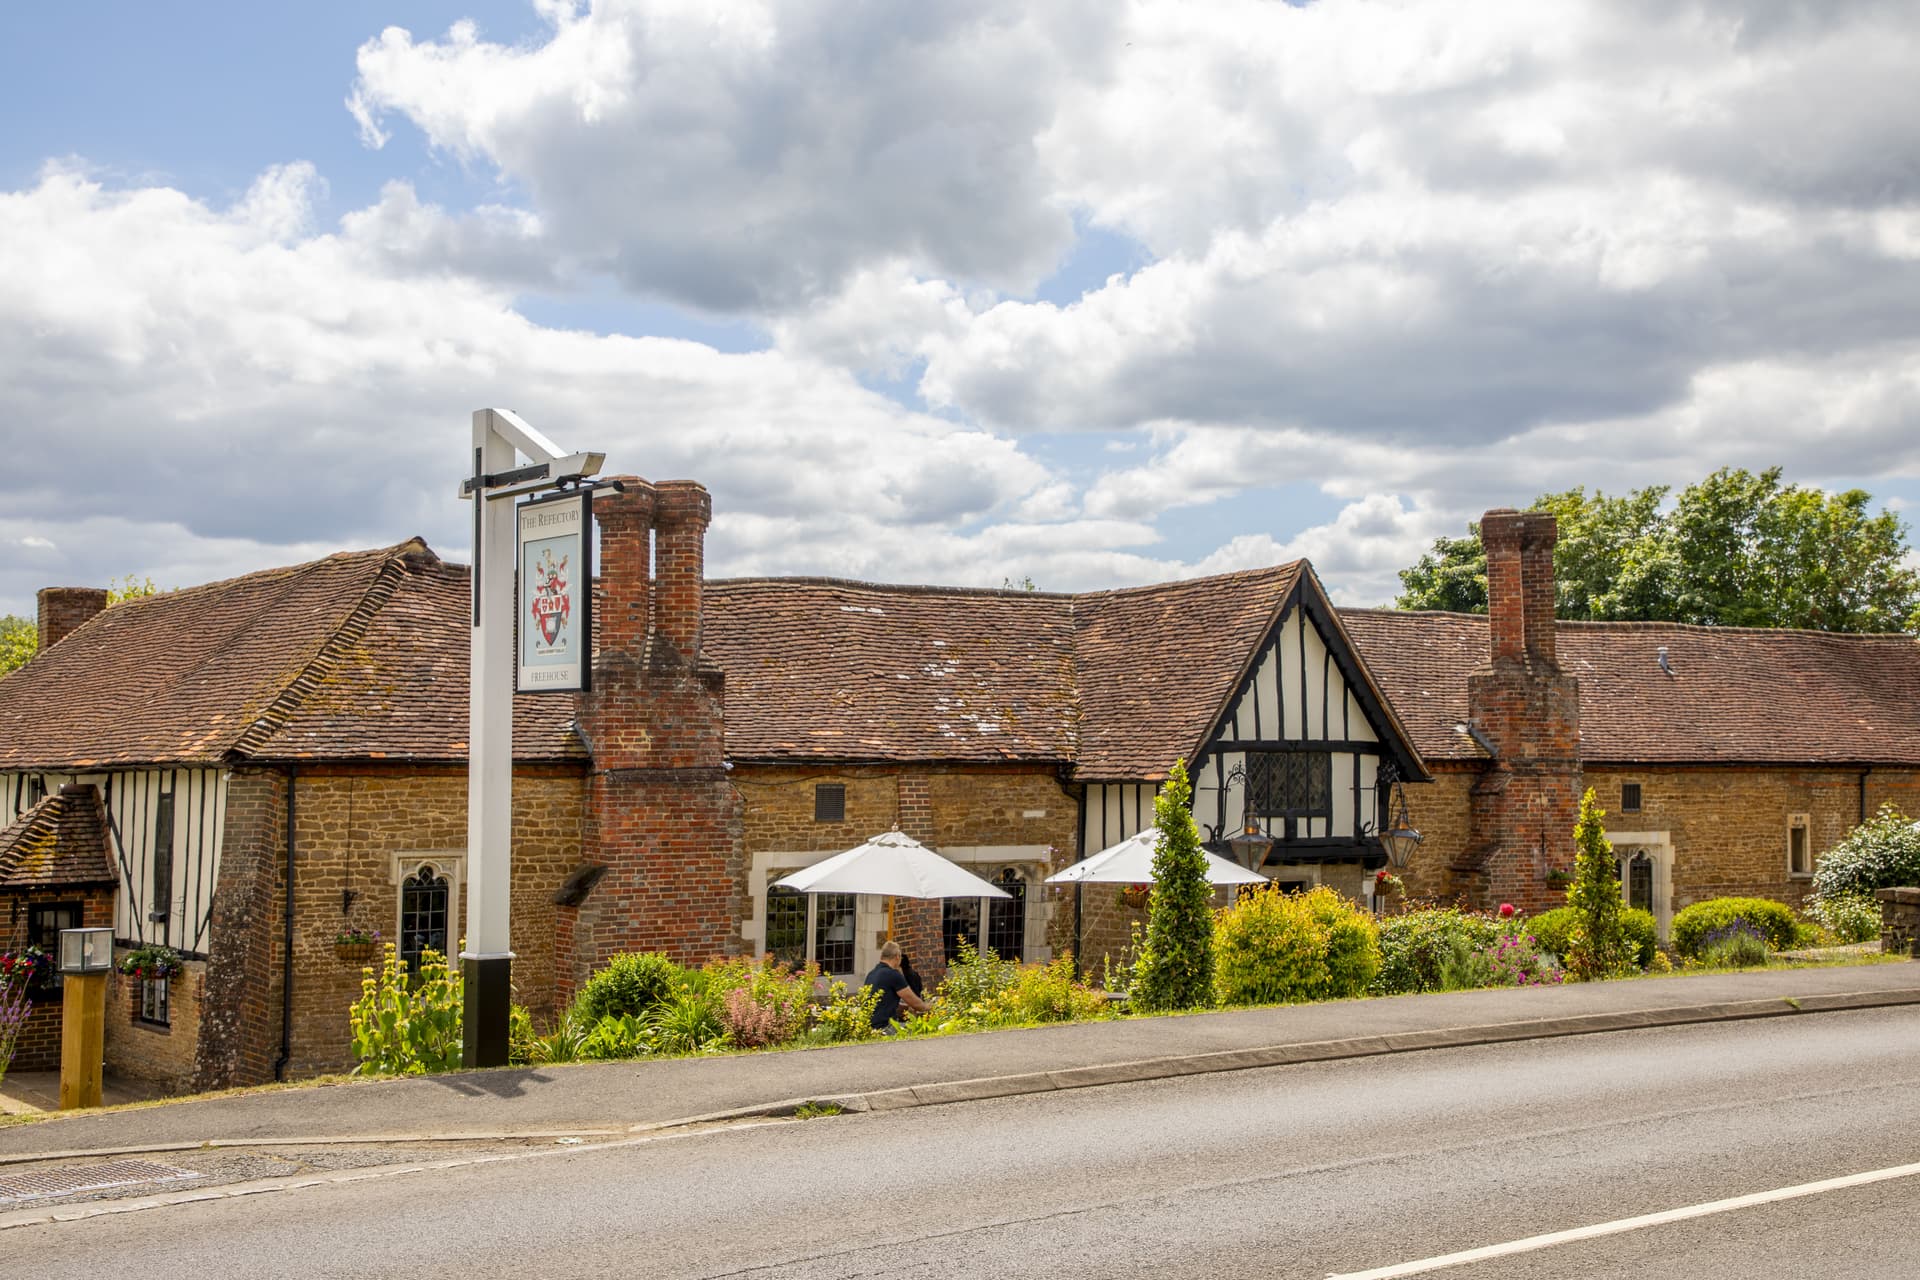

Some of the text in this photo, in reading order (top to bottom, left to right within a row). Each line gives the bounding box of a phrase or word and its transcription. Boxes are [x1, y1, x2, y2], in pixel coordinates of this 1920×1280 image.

[522, 510, 579, 530] THE REFECTORY
[531, 671, 569, 682] FREEHOUSE
